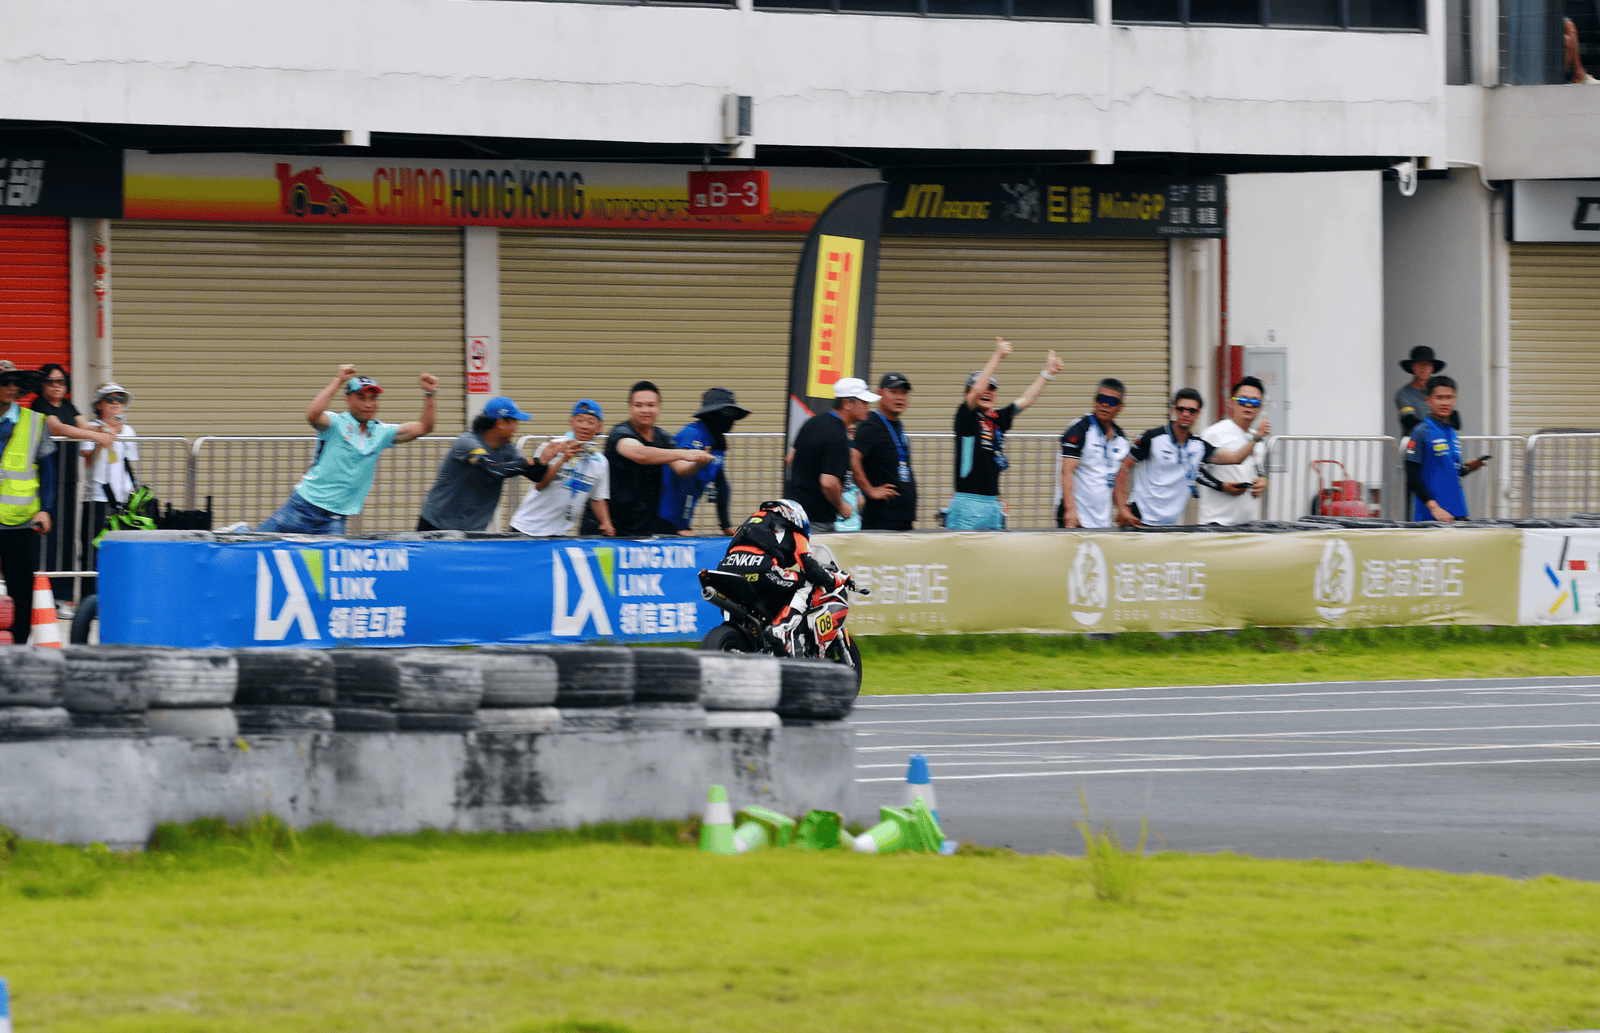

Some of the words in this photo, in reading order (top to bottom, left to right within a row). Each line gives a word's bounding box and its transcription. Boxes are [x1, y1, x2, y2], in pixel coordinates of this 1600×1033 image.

[374, 167, 446, 216] CHINA
[450, 168, 516, 219] HONG
[519, 169, 585, 220] KONG
[329, 549, 409, 571] LINGXIN
[618, 546, 696, 568] LINGXIN
[329, 577, 377, 600] LINK
[618, 574, 665, 596] LINK
[819, 614, 832, 634] 08
